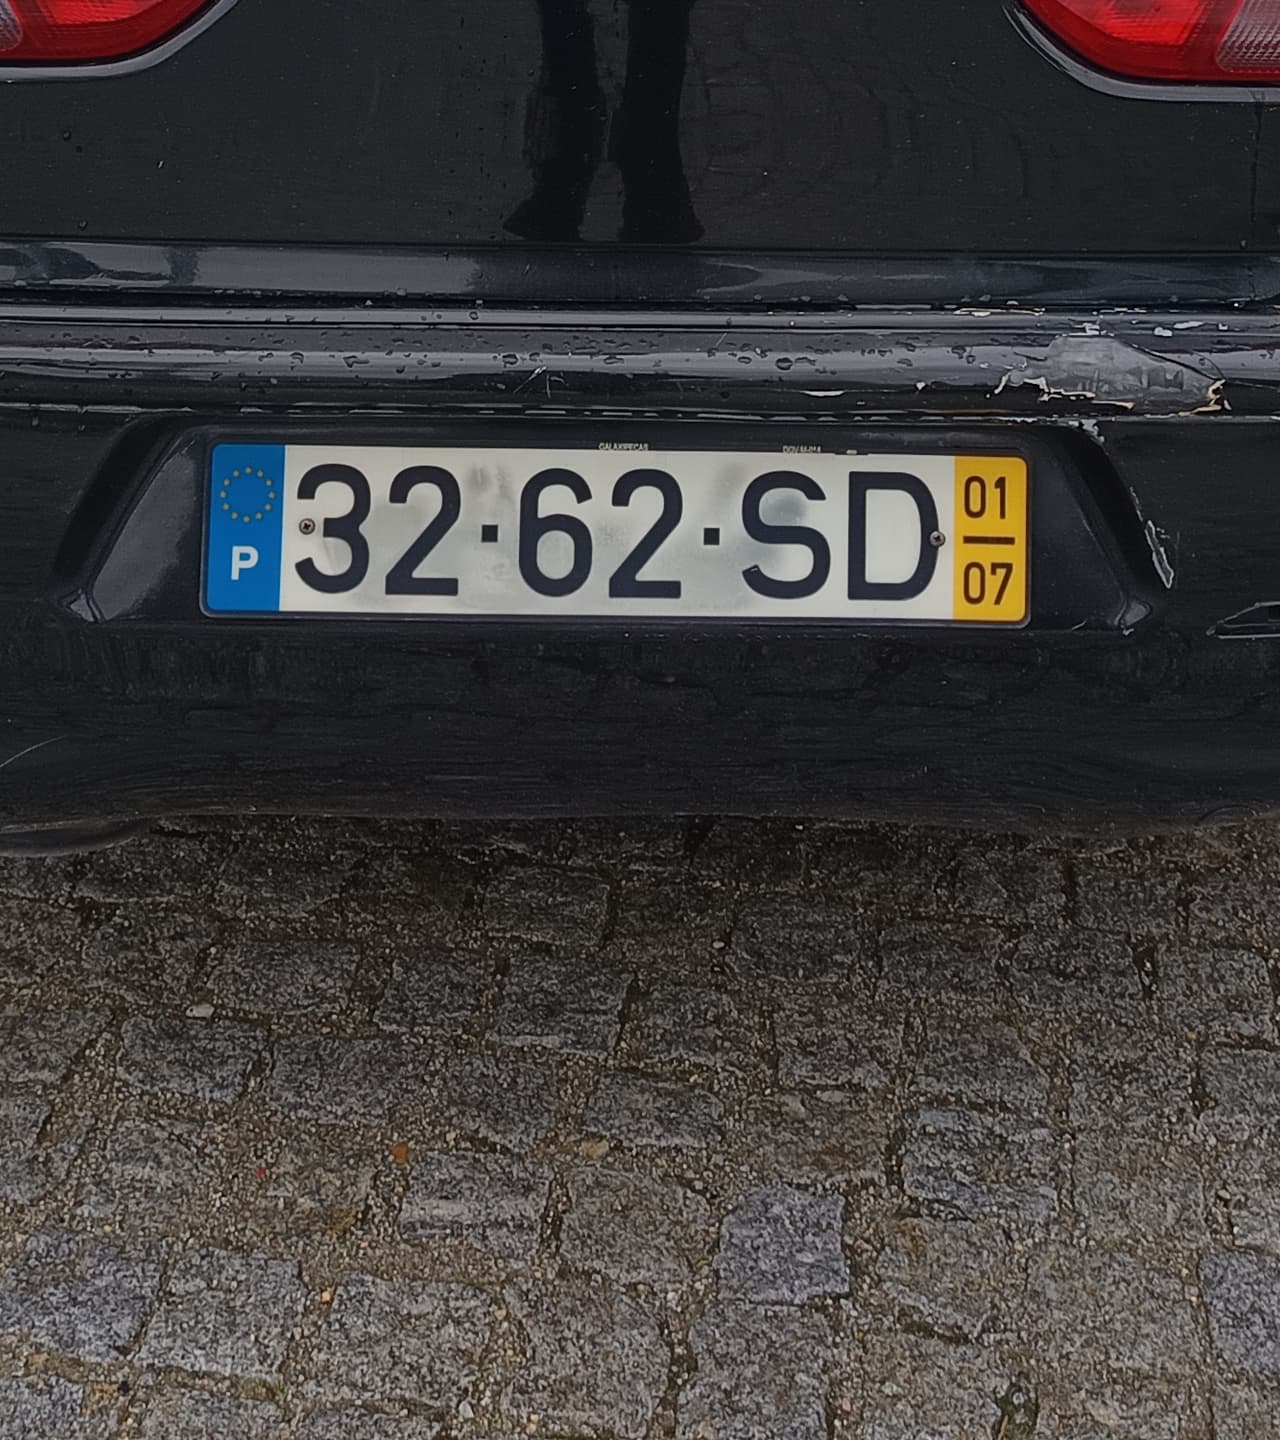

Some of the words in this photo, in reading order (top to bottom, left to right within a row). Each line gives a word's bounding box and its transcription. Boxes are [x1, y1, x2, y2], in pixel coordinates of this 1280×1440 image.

[963, 475, 1007, 520] 01
[231, 545, 259, 581] P
[963, 561, 1014, 606] 07
